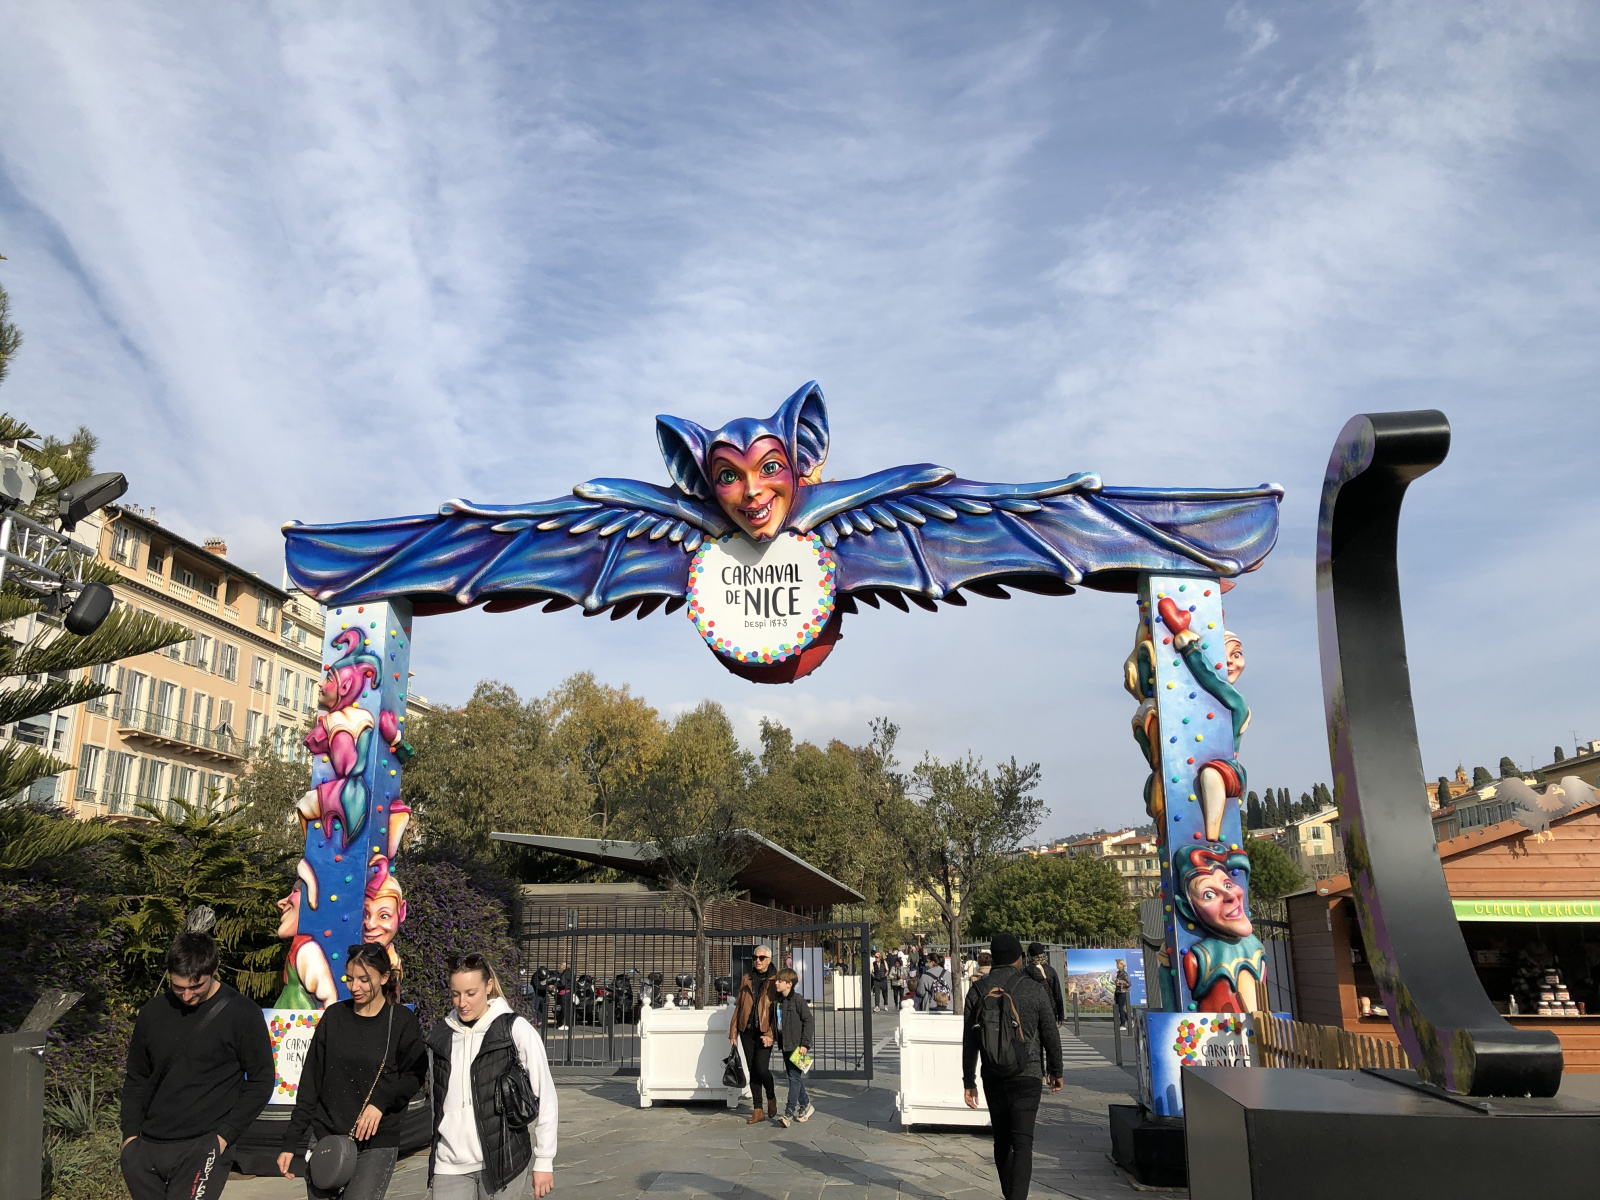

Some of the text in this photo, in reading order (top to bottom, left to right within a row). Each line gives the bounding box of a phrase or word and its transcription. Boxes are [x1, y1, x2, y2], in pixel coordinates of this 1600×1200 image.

[721, 563, 803, 586] CARNAVAL
[725, 587, 801, 618] DE NICE
[769, 619, 788, 628] 1873
[1474, 903, 1594, 917] GLACIER FERACCI
[285, 1038, 312, 1051] CARNA
[1201, 1044, 1251, 1058] CARNAVAL
